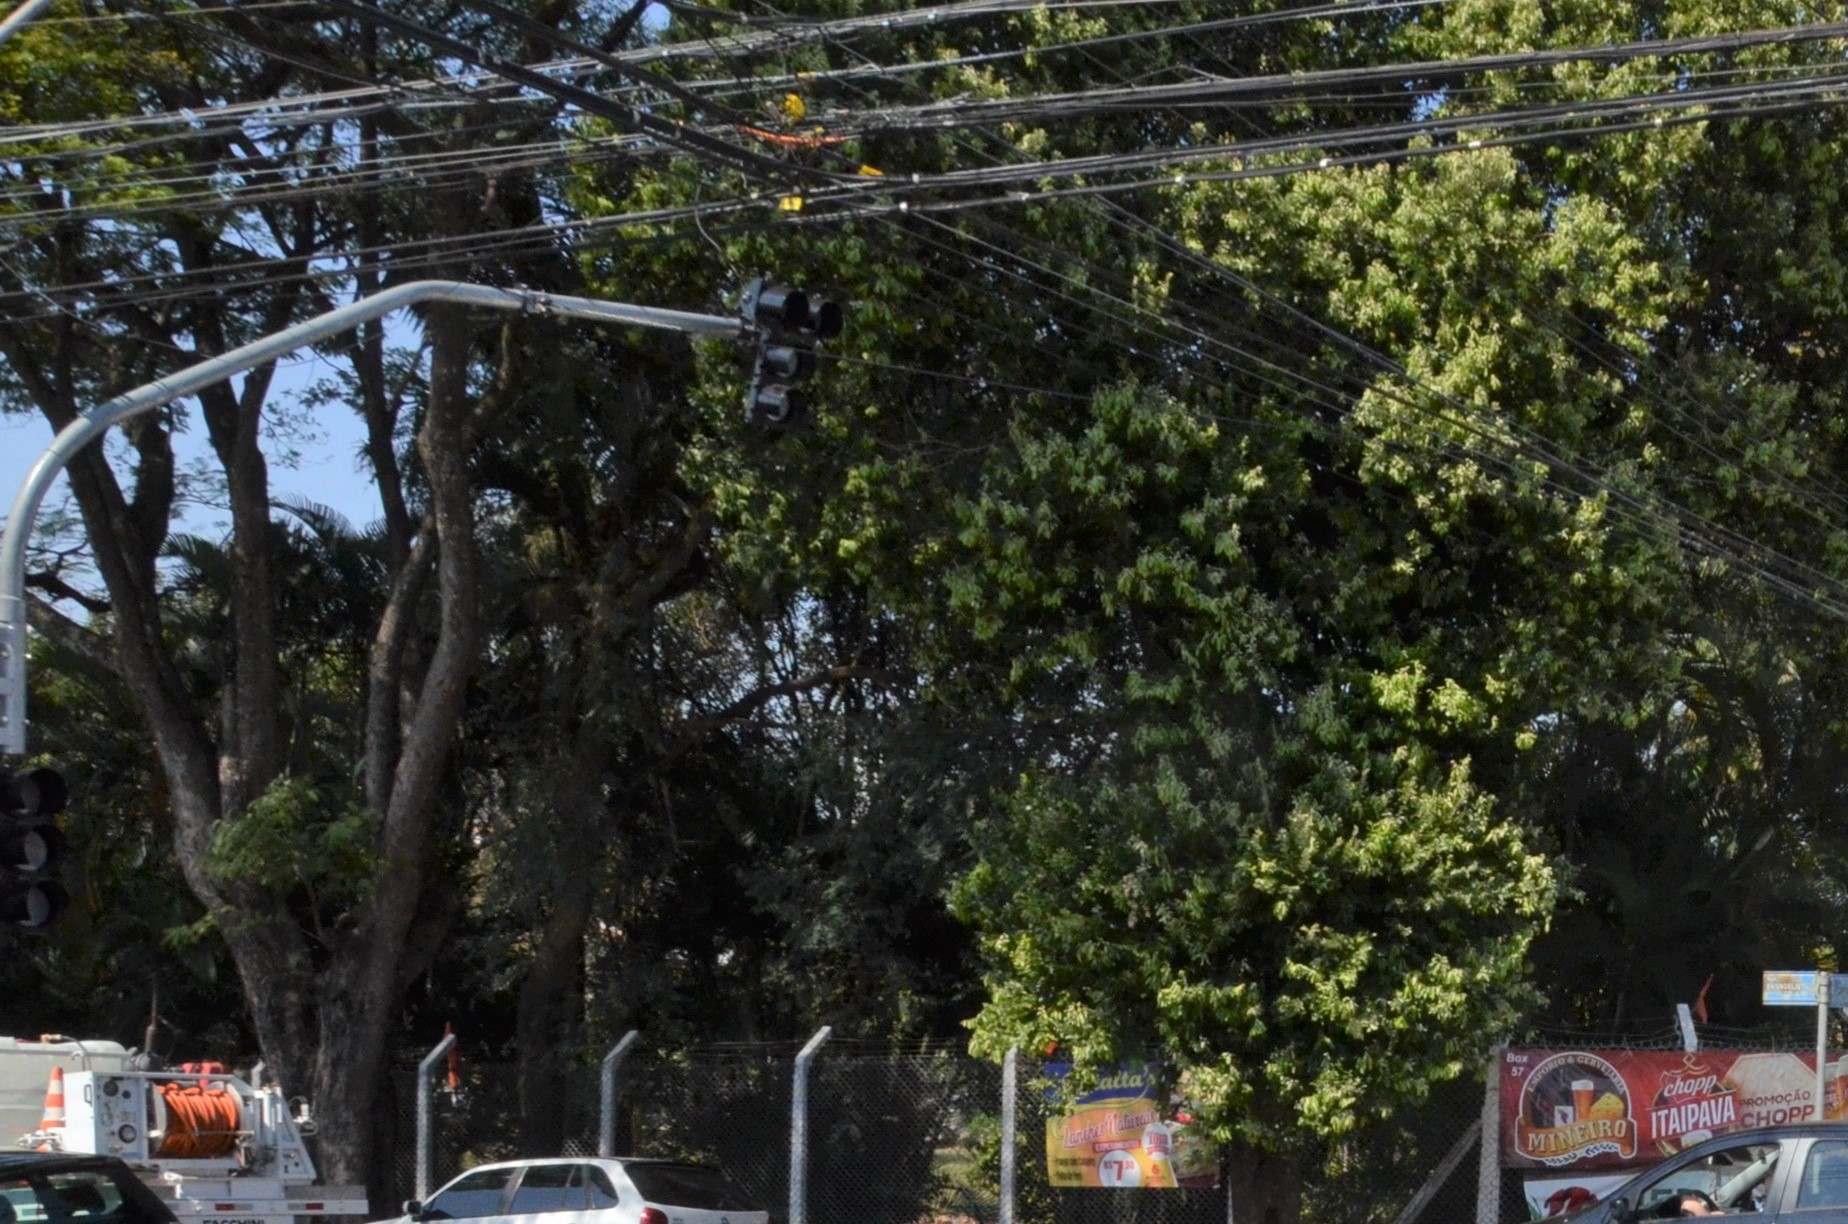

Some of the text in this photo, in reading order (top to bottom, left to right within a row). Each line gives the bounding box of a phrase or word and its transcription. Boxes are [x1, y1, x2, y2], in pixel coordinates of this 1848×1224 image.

[1506, 1053, 1528, 1063] Box
[1511, 1066, 1524, 1077] 57
[1663, 1075, 1717, 1097] chopp
[1739, 1090, 1811, 1108] PROMOÇÃO
[1651, 1096, 1735, 1138] ITAIPAVA
[1740, 1104, 1815, 1128] CHOPP
[1527, 1119, 1627, 1152] MINEIRO
